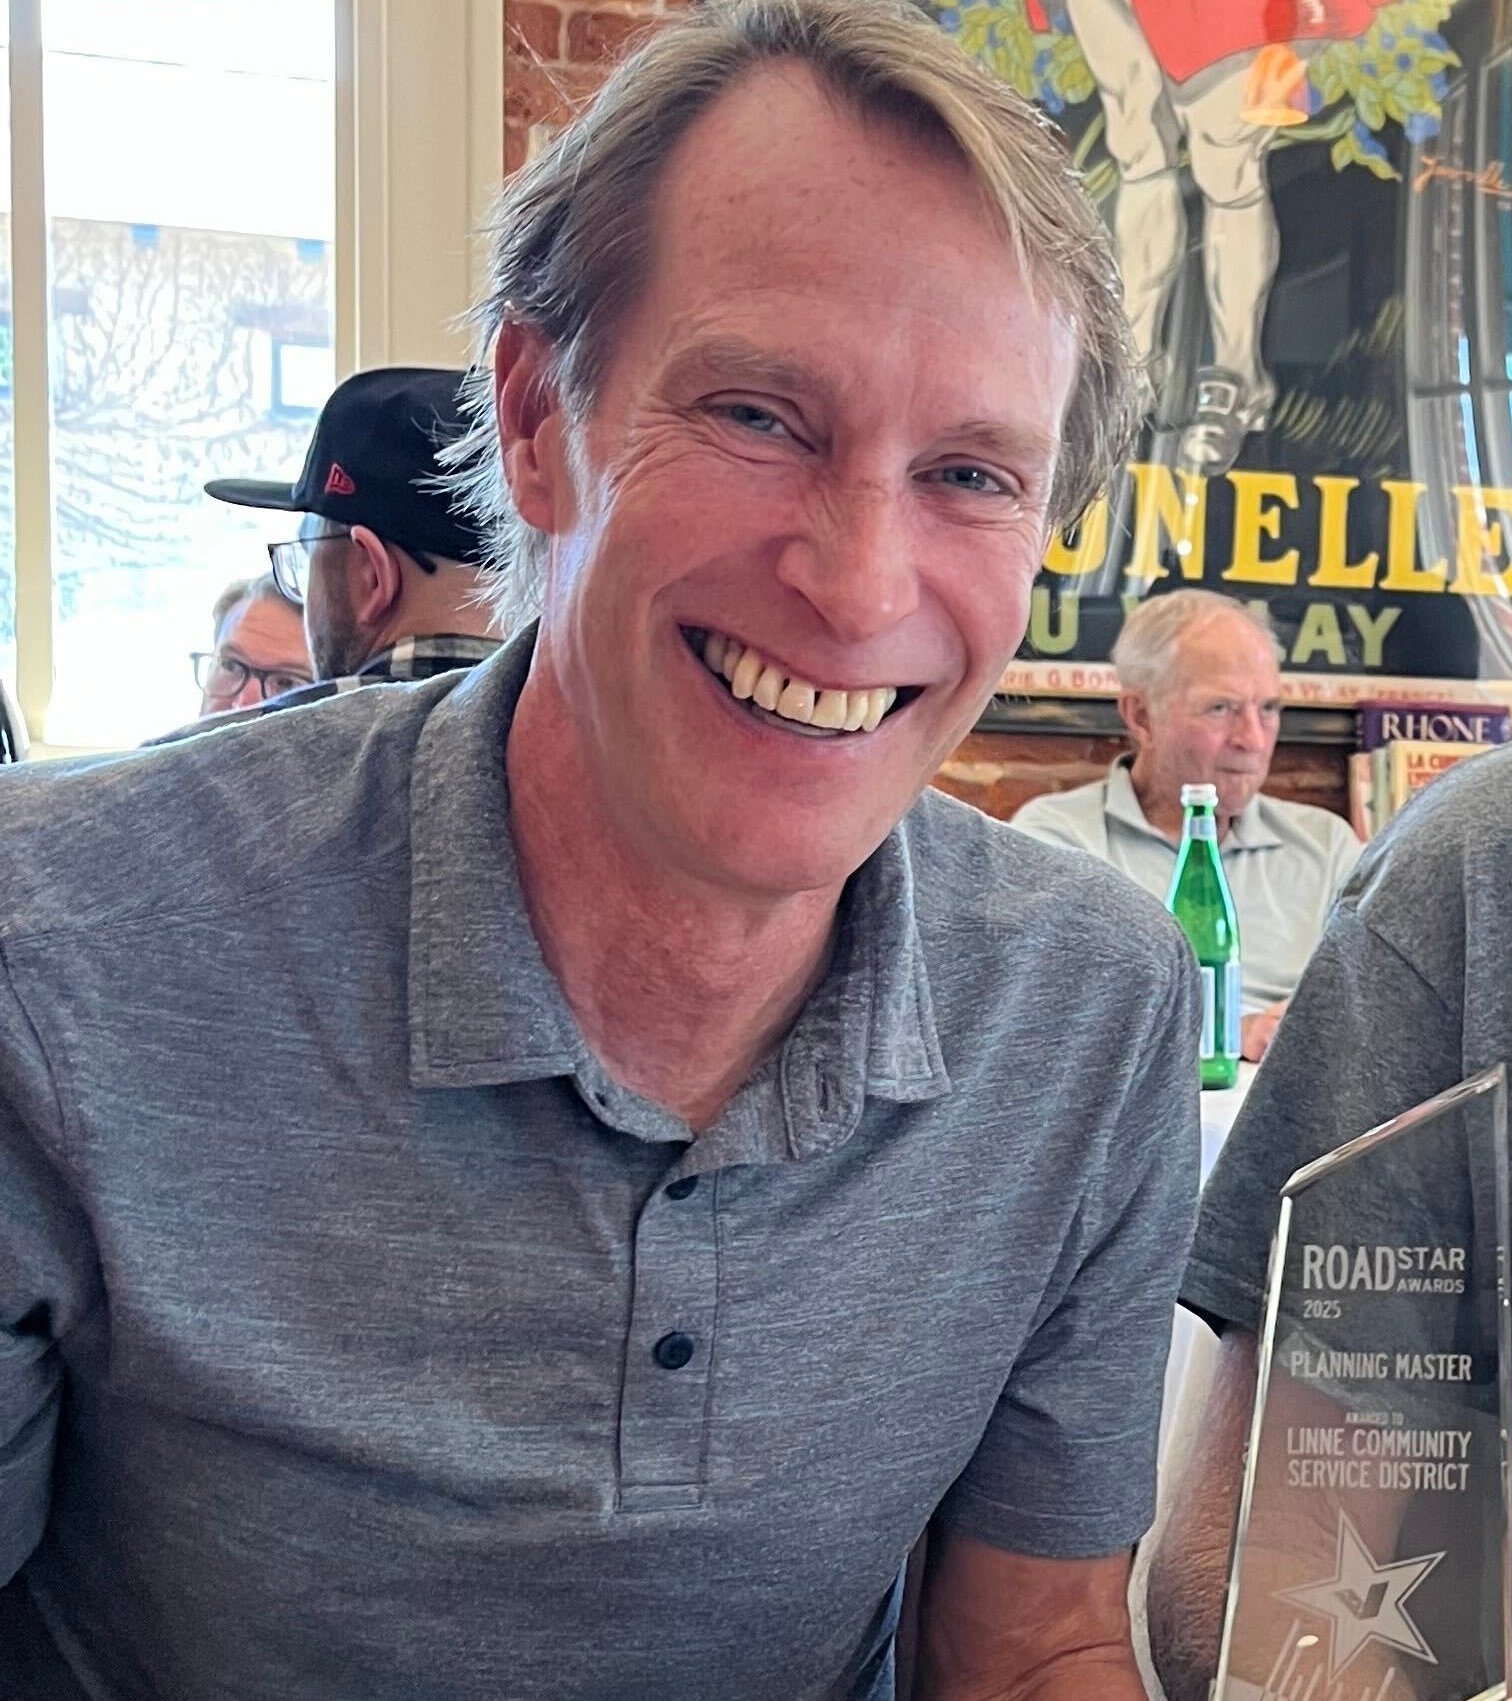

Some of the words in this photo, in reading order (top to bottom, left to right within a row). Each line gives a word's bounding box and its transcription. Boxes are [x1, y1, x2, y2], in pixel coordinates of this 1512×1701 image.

[1382, 713, 1490, 744] RHONE
[1396, 1278, 1465, 1294] AWARDS
[1303, 1300, 1342, 1319] 2025
[1290, 1351, 1388, 1379] PLANNING
[1395, 1353, 1472, 1381] MASTER
[1287, 1427, 1345, 1456] LINNE
[1352, 1429, 1472, 1458] COMMUNITY
[1287, 1459, 1371, 1488] SERVICE
[1379, 1462, 1470, 1491] DISTRICT
